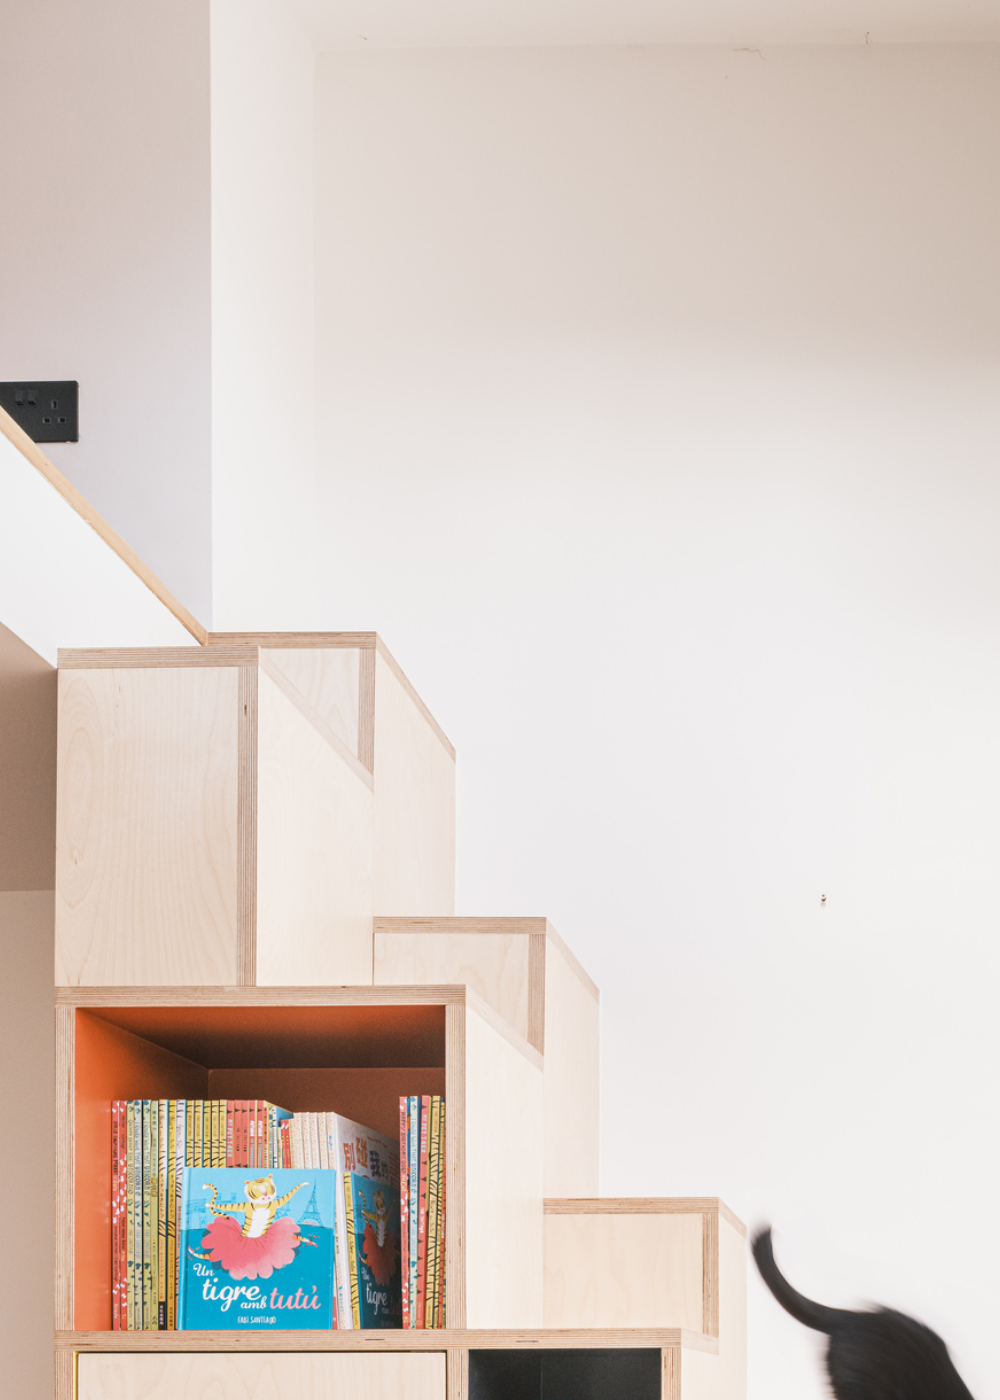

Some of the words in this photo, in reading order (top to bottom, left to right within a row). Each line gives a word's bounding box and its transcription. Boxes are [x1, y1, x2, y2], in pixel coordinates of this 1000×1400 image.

[193, 1263, 214, 1276] Un
[202, 1278, 262, 1312] tigre
[240, 1296, 267, 1309] amb
[270, 1285, 321, 1309] tutú
